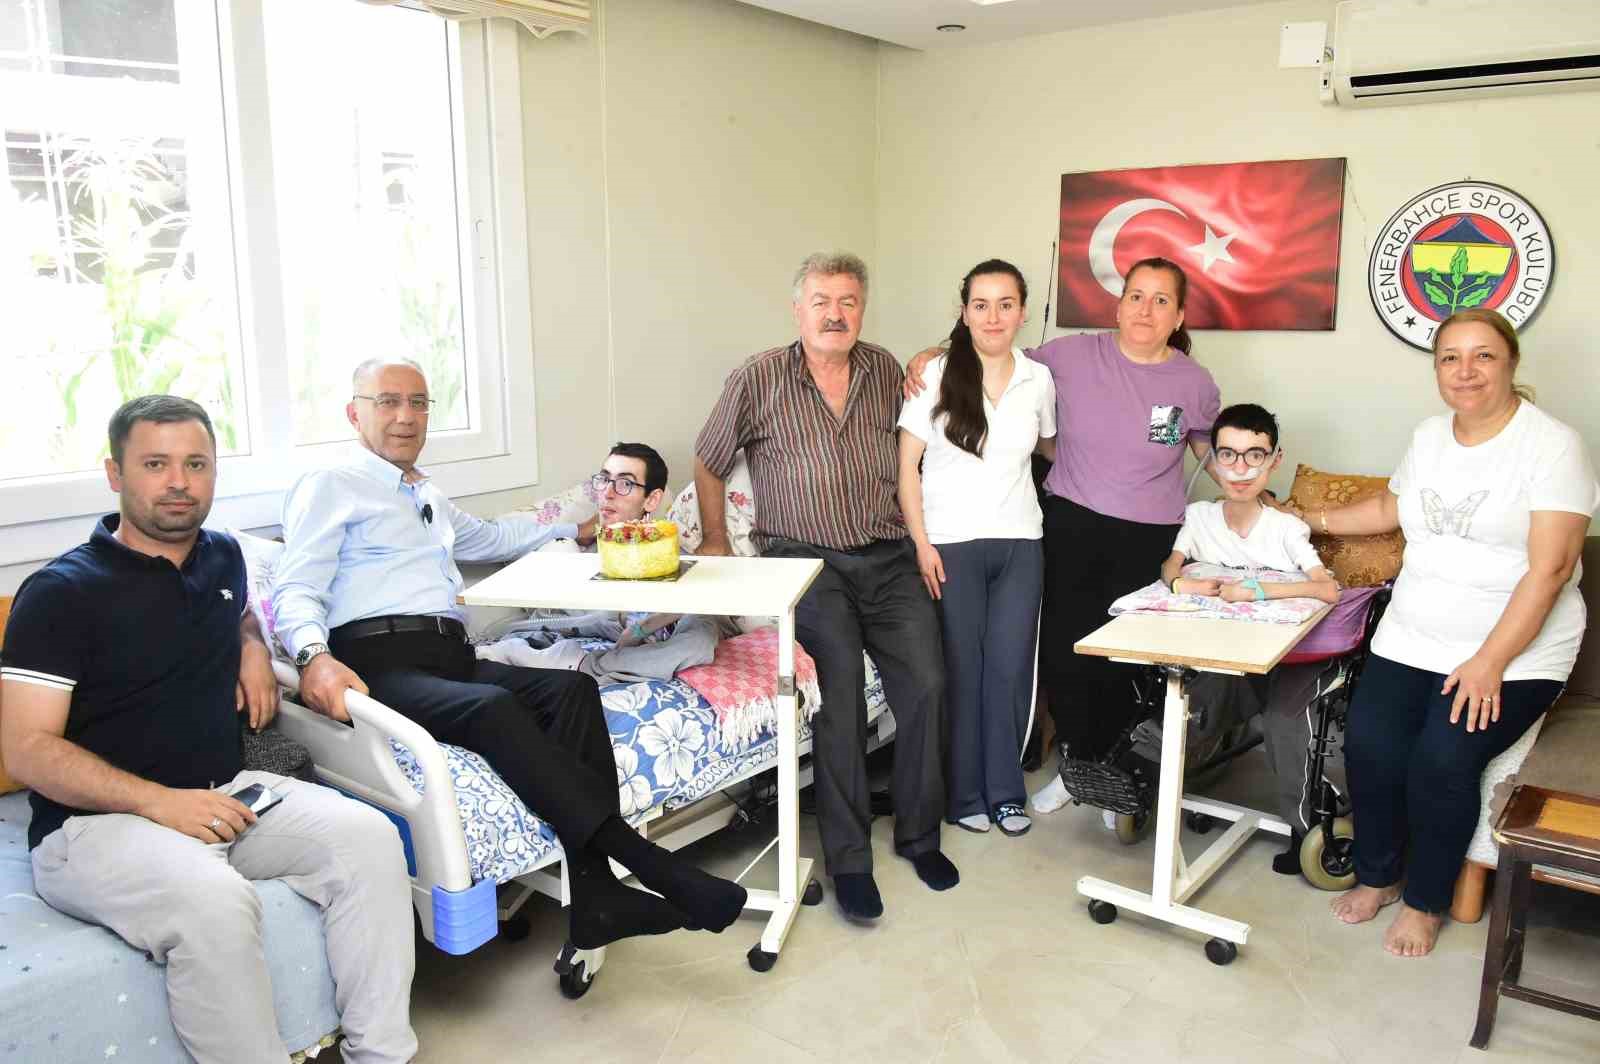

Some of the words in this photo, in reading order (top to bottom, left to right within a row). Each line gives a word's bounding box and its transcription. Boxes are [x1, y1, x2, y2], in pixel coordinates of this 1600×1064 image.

[1379, 192, 1462, 314] FENERBAHÇE
[1469, 191, 1530, 232] SPOR
[1505, 231, 1546, 323] KULÜBÜ
